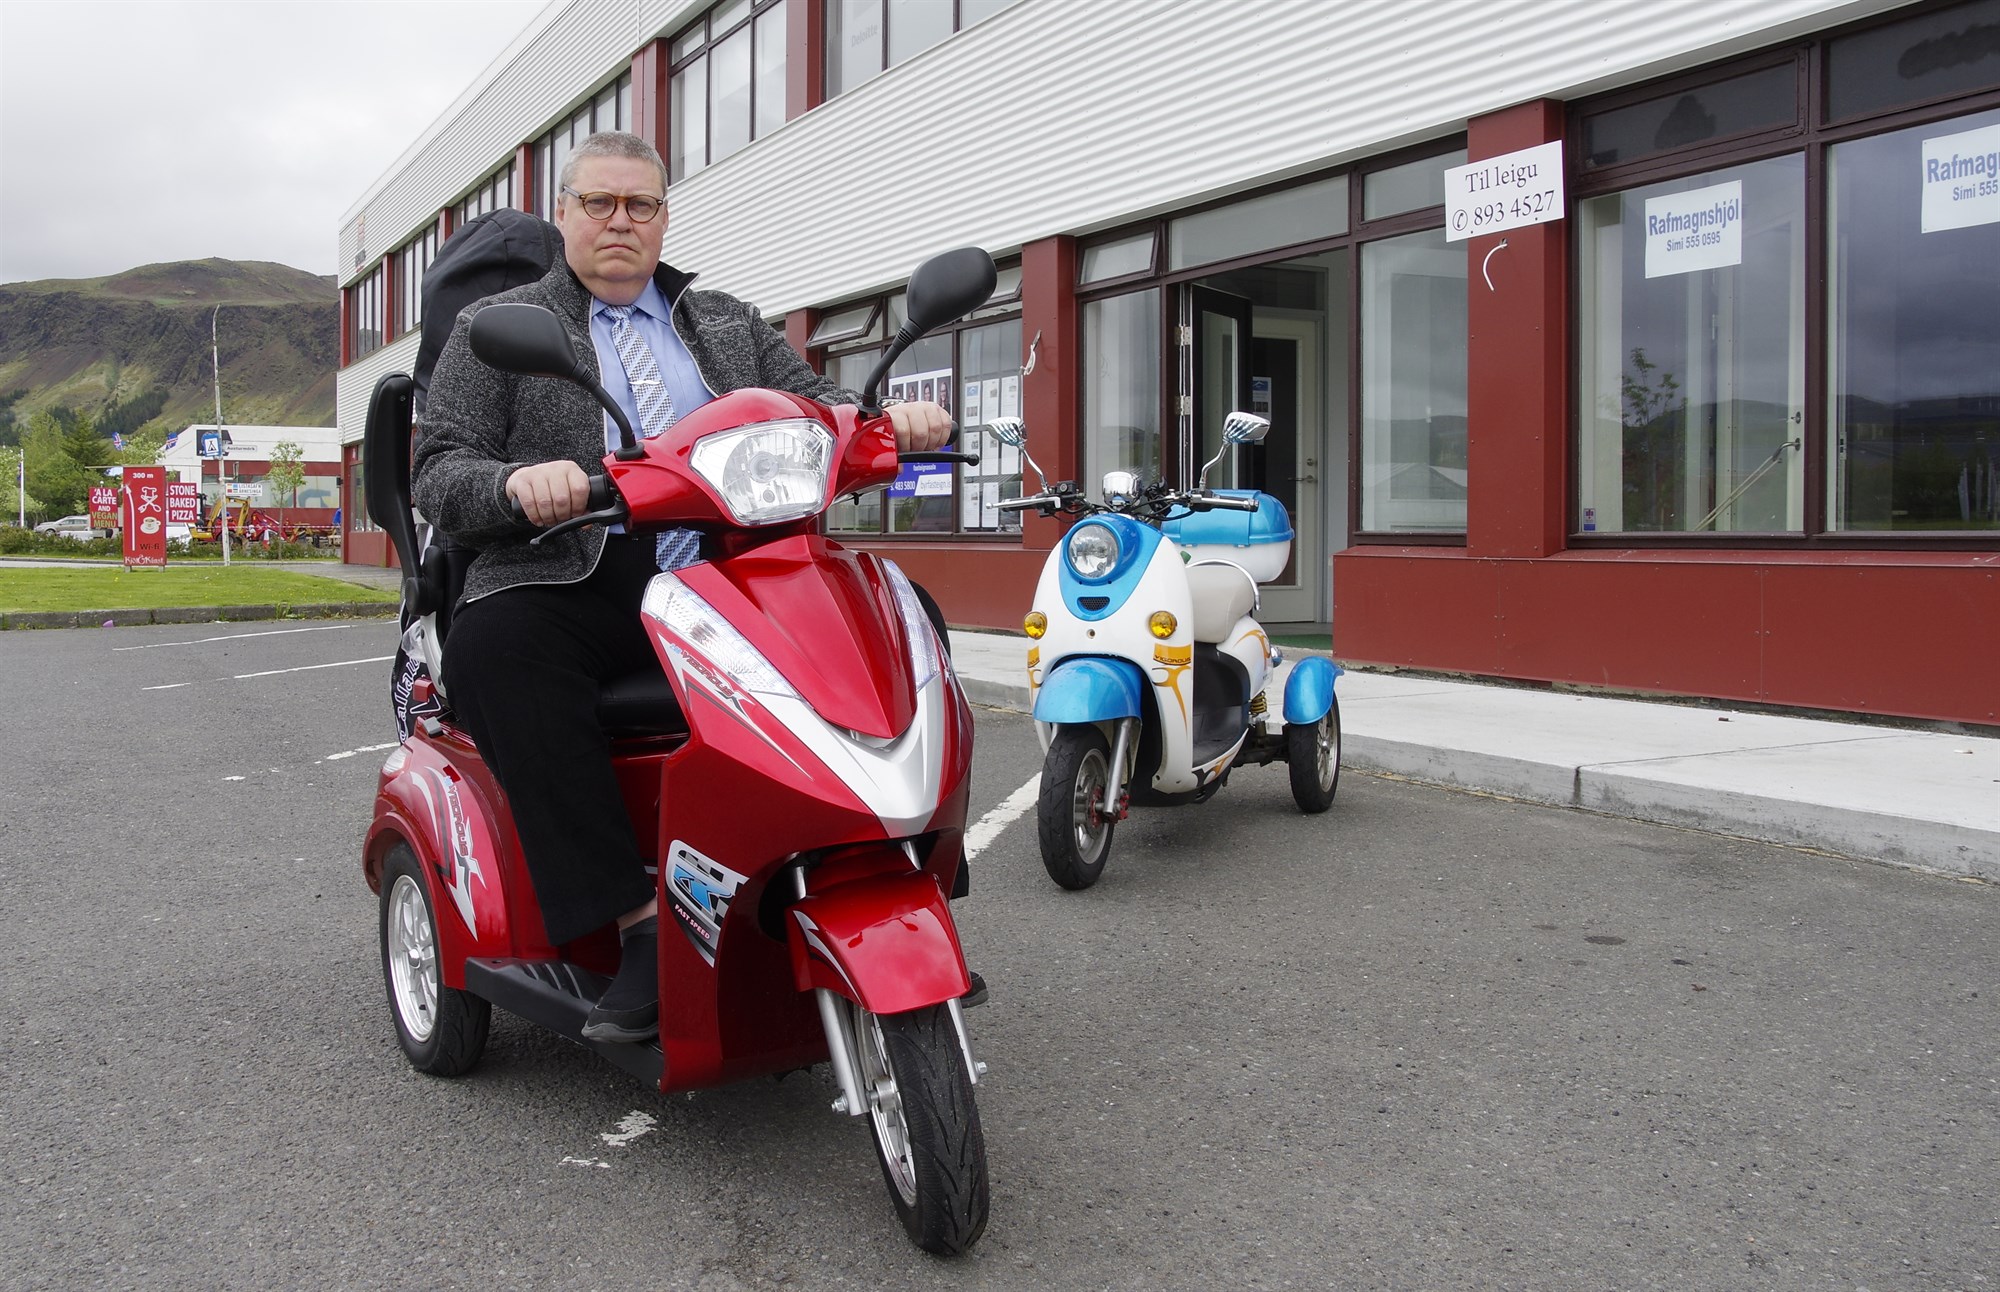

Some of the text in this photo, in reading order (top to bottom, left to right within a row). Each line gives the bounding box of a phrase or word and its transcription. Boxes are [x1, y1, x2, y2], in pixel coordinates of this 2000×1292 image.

[1927, 151, 2000, 184] Rafmag
[1465, 163, 1538, 193] Til leigu
[1953, 179, 1999, 201] Sími 555
[1473, 189, 1555, 226] 893 4527
[1648, 198, 1739, 236] Rafmagnshjól
[1666, 231, 1721, 252] Sími 555 0595
[169, 485, 195, 496] STONE
[904, 480, 916, 490] 5800
[103, 488, 113, 497] LA
[92, 496, 117, 505] CARTE
[169, 497, 196, 508] BAKED
[91, 511, 117, 520] VEGAN
[171, 510, 194, 520] PIZZA
[93, 519, 116, 528] MENU
[674, 903, 711, 940] FAST SPEED
